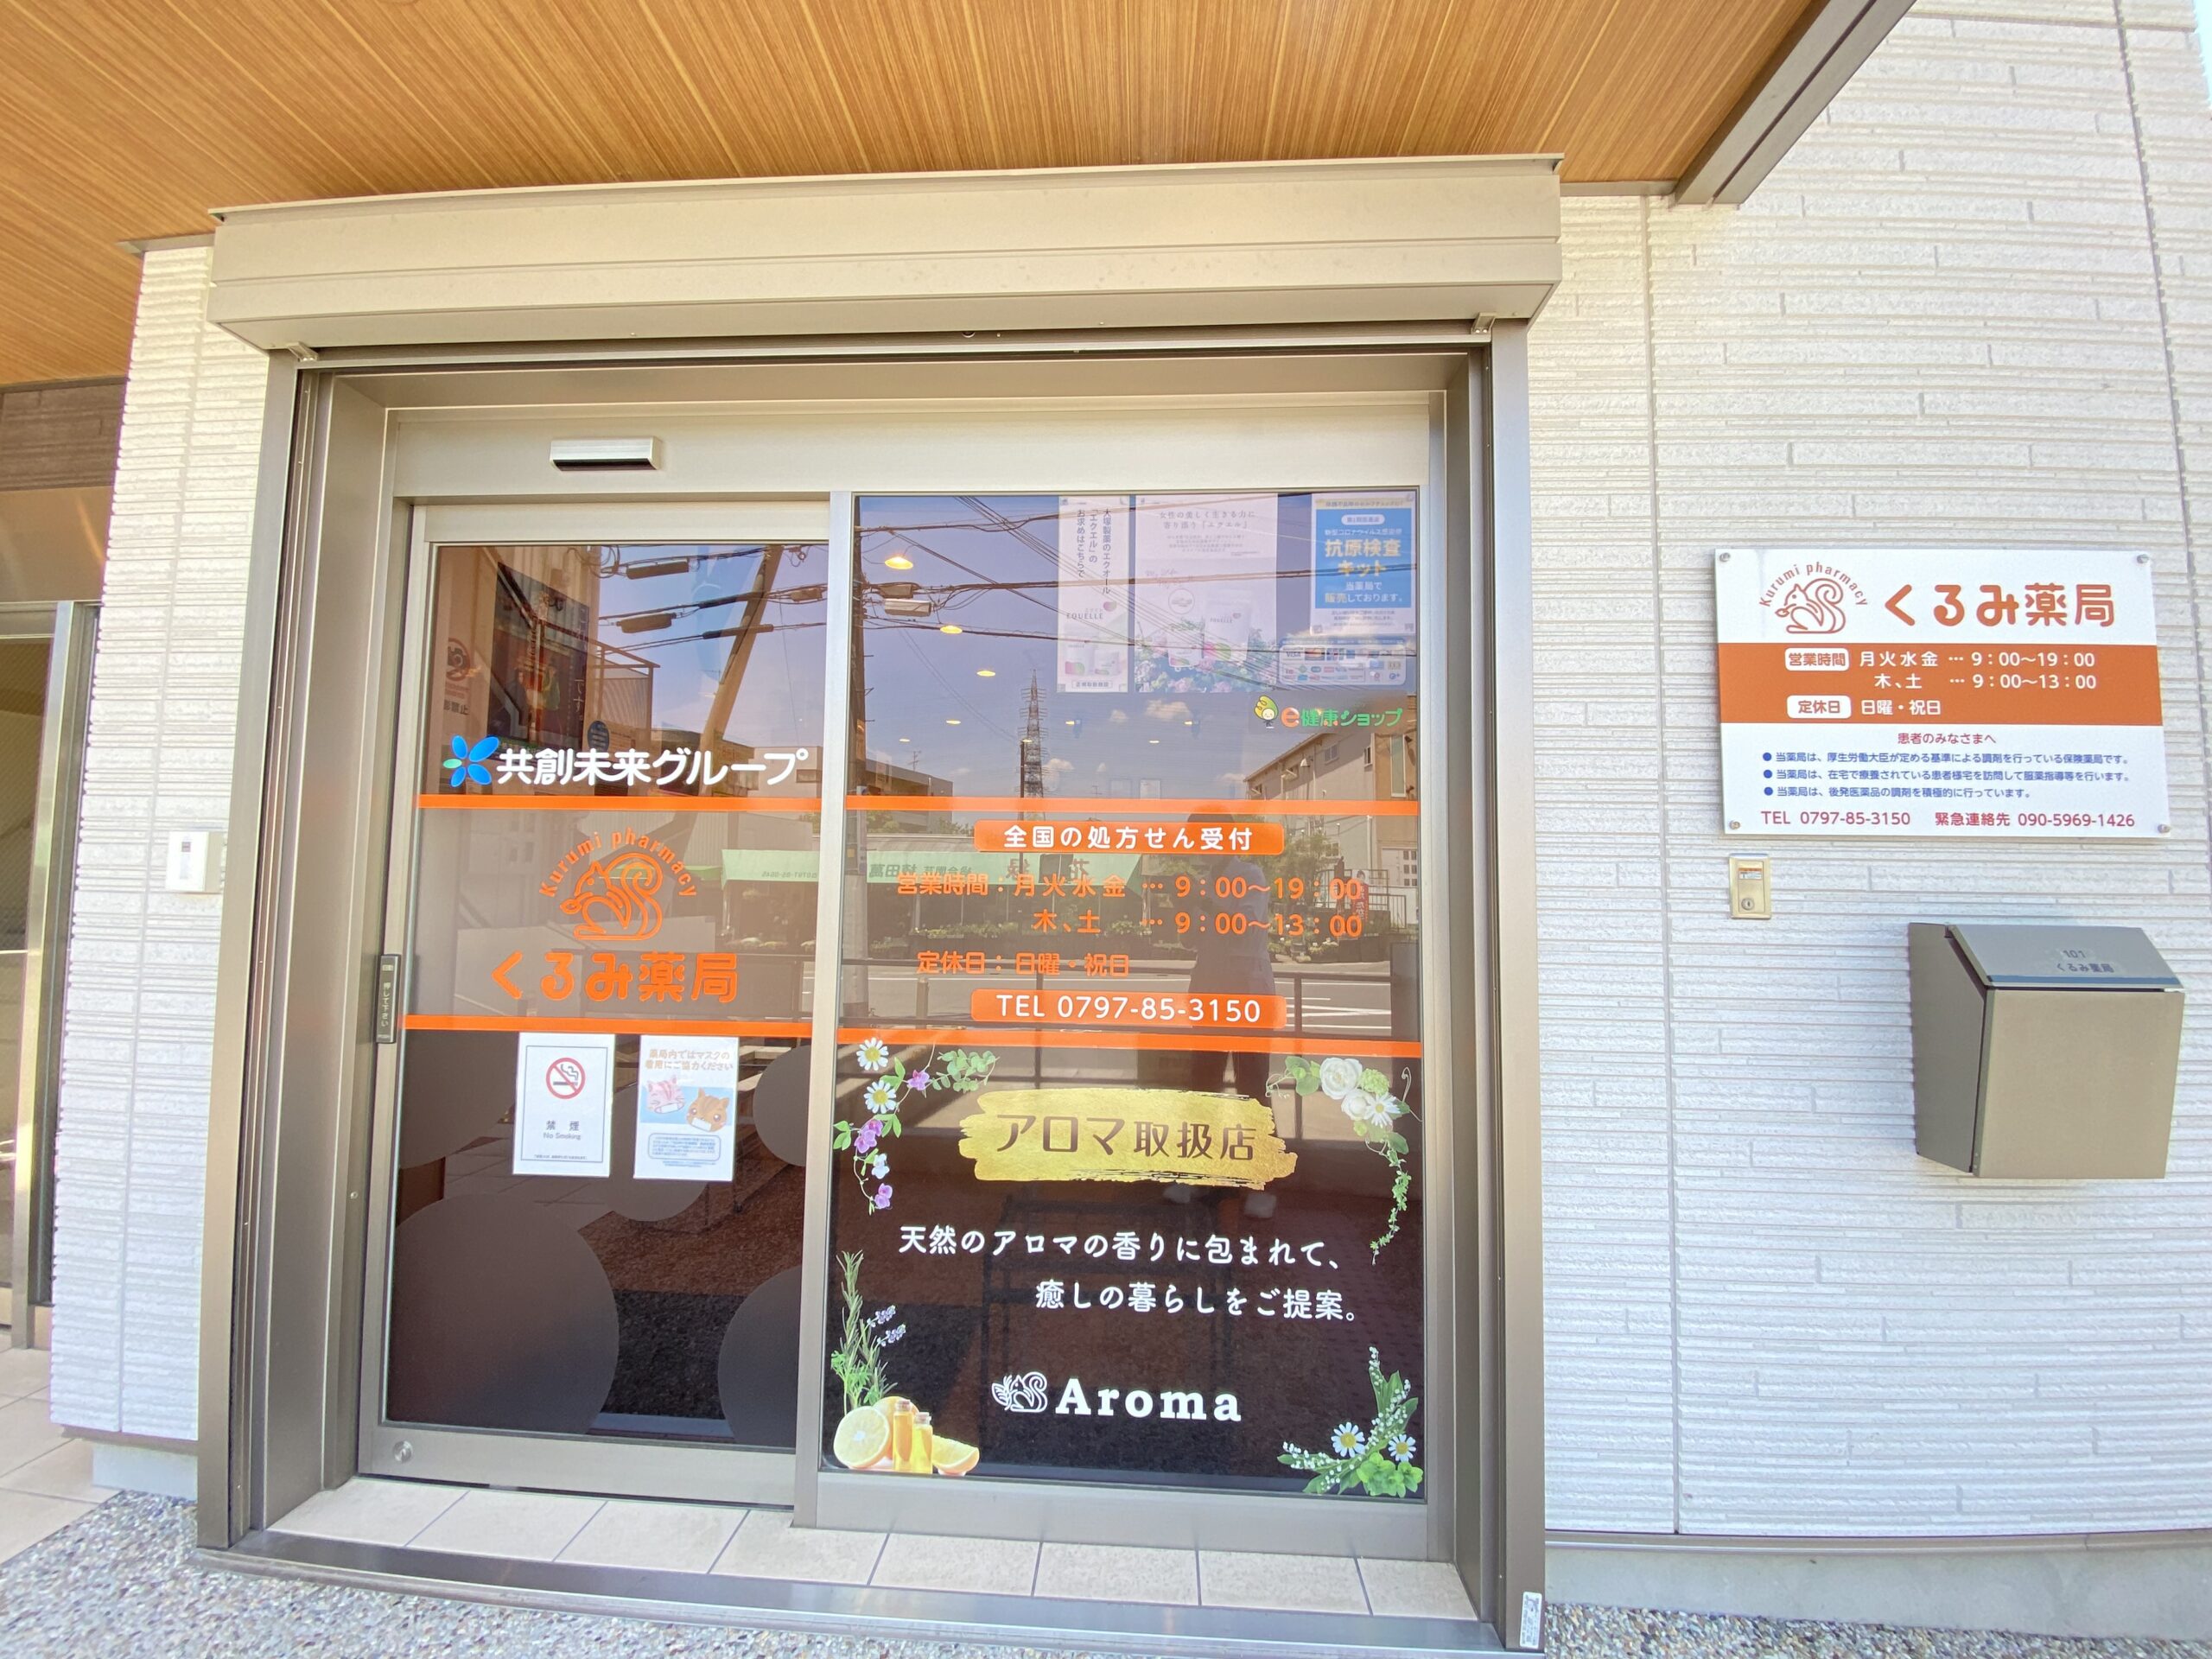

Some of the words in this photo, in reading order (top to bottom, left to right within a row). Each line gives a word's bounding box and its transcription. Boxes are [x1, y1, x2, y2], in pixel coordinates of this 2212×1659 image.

[1325, 538, 1402, 557] 抗原検査
[1338, 560, 1387, 577] キット
[1345, 582, 1382, 591] 当薬局で
[1758, 564, 1800, 607] Kurumi
[1806, 562, 1868, 607] pharmacy
[1885, 582, 2115, 627] くるみ薬局
[1789, 652, 1846, 667] 営業時間
[1874, 673, 1923, 689] 木、土
[1281, 707, 1403, 728] e健康ショップ
[1798, 701, 1840, 714] 定休日
[1860, 699, 1941, 715] 日曜・祝日
[1897, 733, 1997, 745] 患者のみなさまへ
[497, 748, 810, 786] 共創未来グループ
[1777, 786, 2031, 798] 当薬局は、後発医薬品の調剤を積極的に行っています。
[1760, 810, 1791, 824] TEL
[1800, 811, 1910, 825] 0797-85-3150
[1935, 812, 2011, 826] 緊急連絡先
[2018, 813, 2135, 827] 090-5969-1426
[1003, 824, 1254, 852] 全国の処方せん受付
[538, 831, 602, 898] Kurumi
[611, 827, 696, 898] pharmacy
[1033, 910, 1102, 934] 木、土
[2063, 950, 2085, 958] 101
[491, 951, 739, 1004] くるみ薬局
[2056, 962, 2115, 973] くるみ薬局
[996, 994, 1046, 1019] TEL
[1057, 995, 1261, 1024] 0797-85-3150
[996, 1113, 1256, 1161] アロマ取扱店
[899, 1224, 1340, 1270] 天然のアロマの香りに包まれて、
[1035, 1279, 1356, 1323] 癒しの暮らしをご提案。
[1054, 1377, 1242, 1422] Aroma
